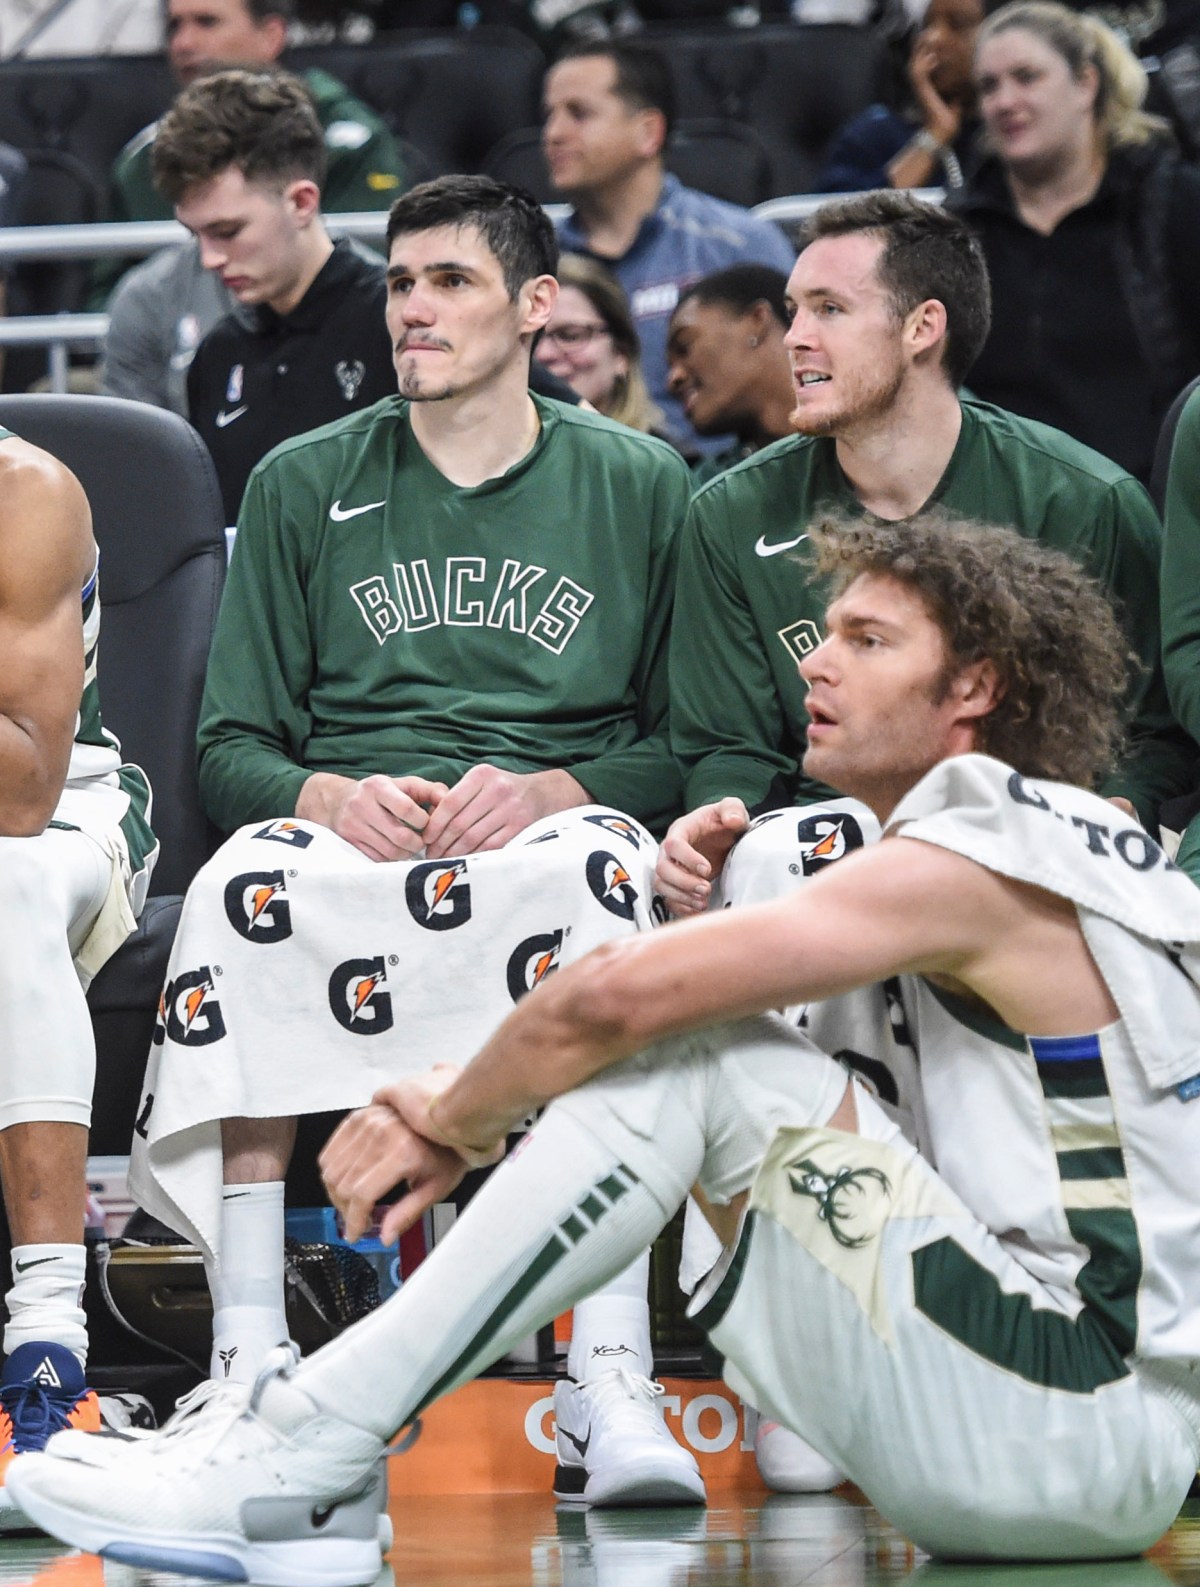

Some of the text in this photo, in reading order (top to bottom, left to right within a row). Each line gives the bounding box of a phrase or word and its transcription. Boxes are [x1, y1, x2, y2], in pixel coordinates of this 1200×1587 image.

[349, 556, 595, 656] BUCKS
[224, 869, 294, 944] G
[405, 859, 472, 932] G
[166, 965, 228, 1047] G
[328, 956, 394, 1036] G
